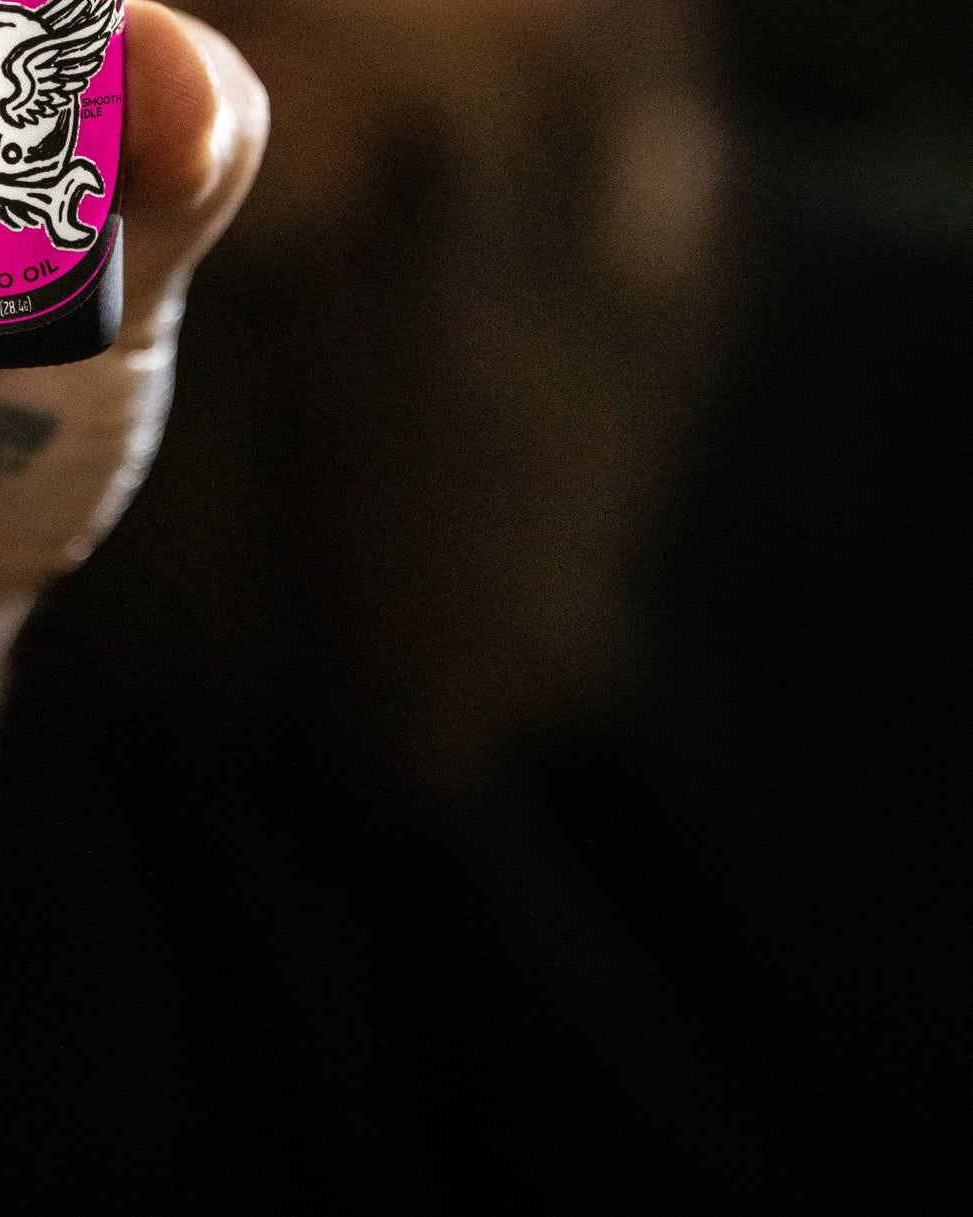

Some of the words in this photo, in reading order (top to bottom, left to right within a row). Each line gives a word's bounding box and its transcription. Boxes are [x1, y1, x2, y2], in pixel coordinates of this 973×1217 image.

[82, 95, 122, 107] SMOOTH
[81, 107, 103, 119] IDLE
[23, 259, 59, 282] OIL
